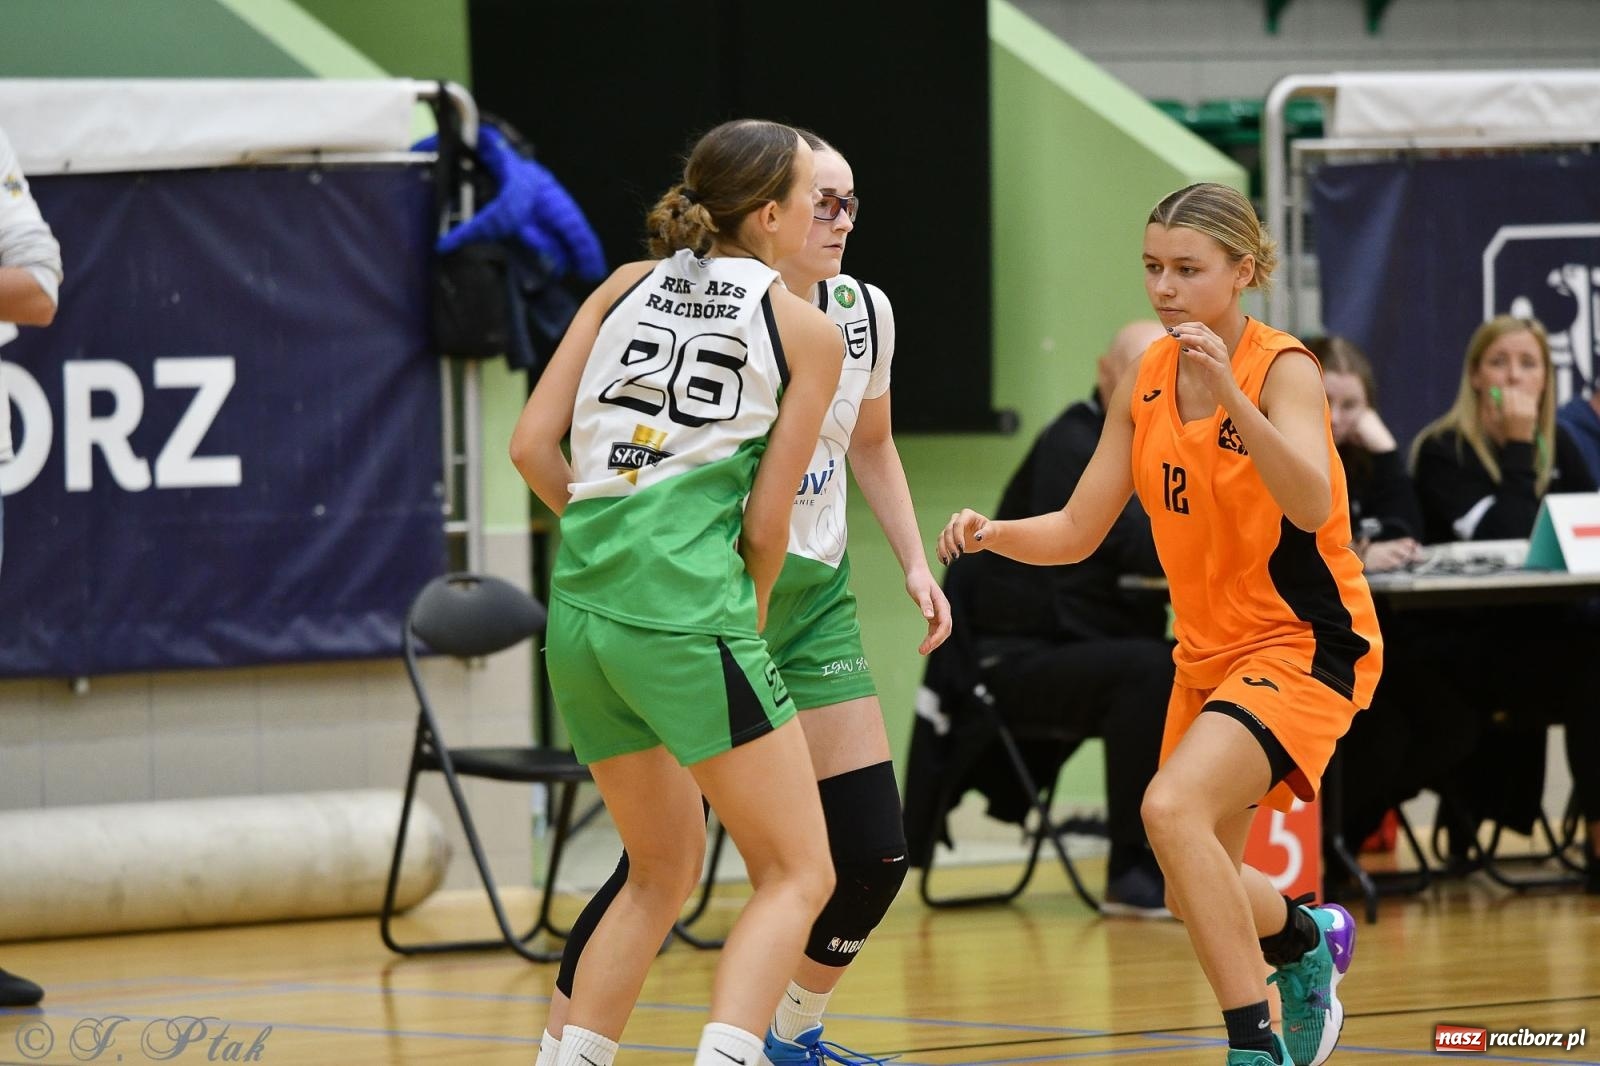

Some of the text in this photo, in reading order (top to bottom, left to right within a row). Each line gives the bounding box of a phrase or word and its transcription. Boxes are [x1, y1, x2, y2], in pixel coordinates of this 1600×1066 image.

[645, 293, 741, 320] RACIBÓRZ
[705, 280, 747, 299] AZS
[836, 318, 868, 360] 5
[598, 321, 748, 428] 26
[1162, 462, 1190, 515] 12
[1265, 796, 1306, 893] 5
